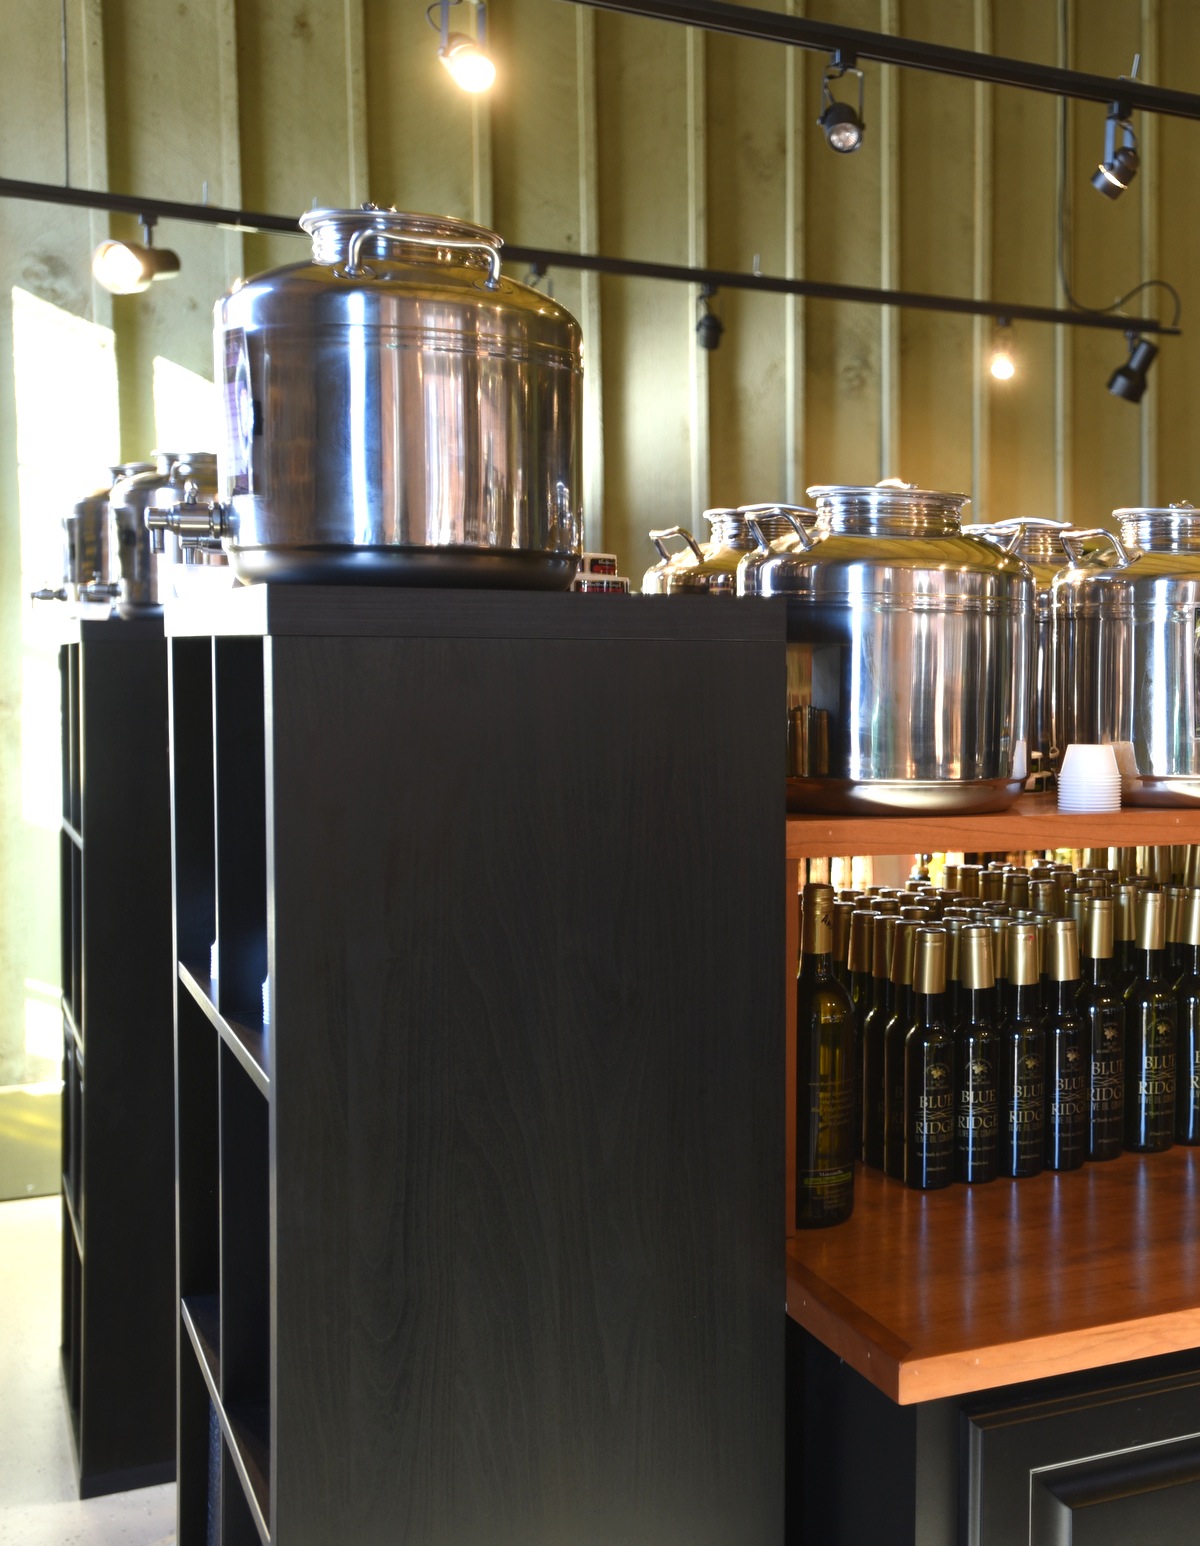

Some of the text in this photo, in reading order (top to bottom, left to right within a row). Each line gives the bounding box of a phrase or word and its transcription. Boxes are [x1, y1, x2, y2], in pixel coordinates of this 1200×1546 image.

[1092, 1060, 1124, 1075] BLU
[1013, 1083, 1044, 1098] BLU
[1055, 1077, 1086, 1091] BLU
[1138, 1081, 1176, 1095] RIDG
[919, 1093, 953, 1109] BLUE
[961, 1089, 996, 1104] BLUE
[1089, 1086, 1124, 1102] RIDG
[1009, 1110, 1044, 1123] RIDG
[1051, 1102, 1087, 1116] RIDG
[915, 1119, 954, 1135] RIDG
[957, 1115, 999, 1129] RIDGE
